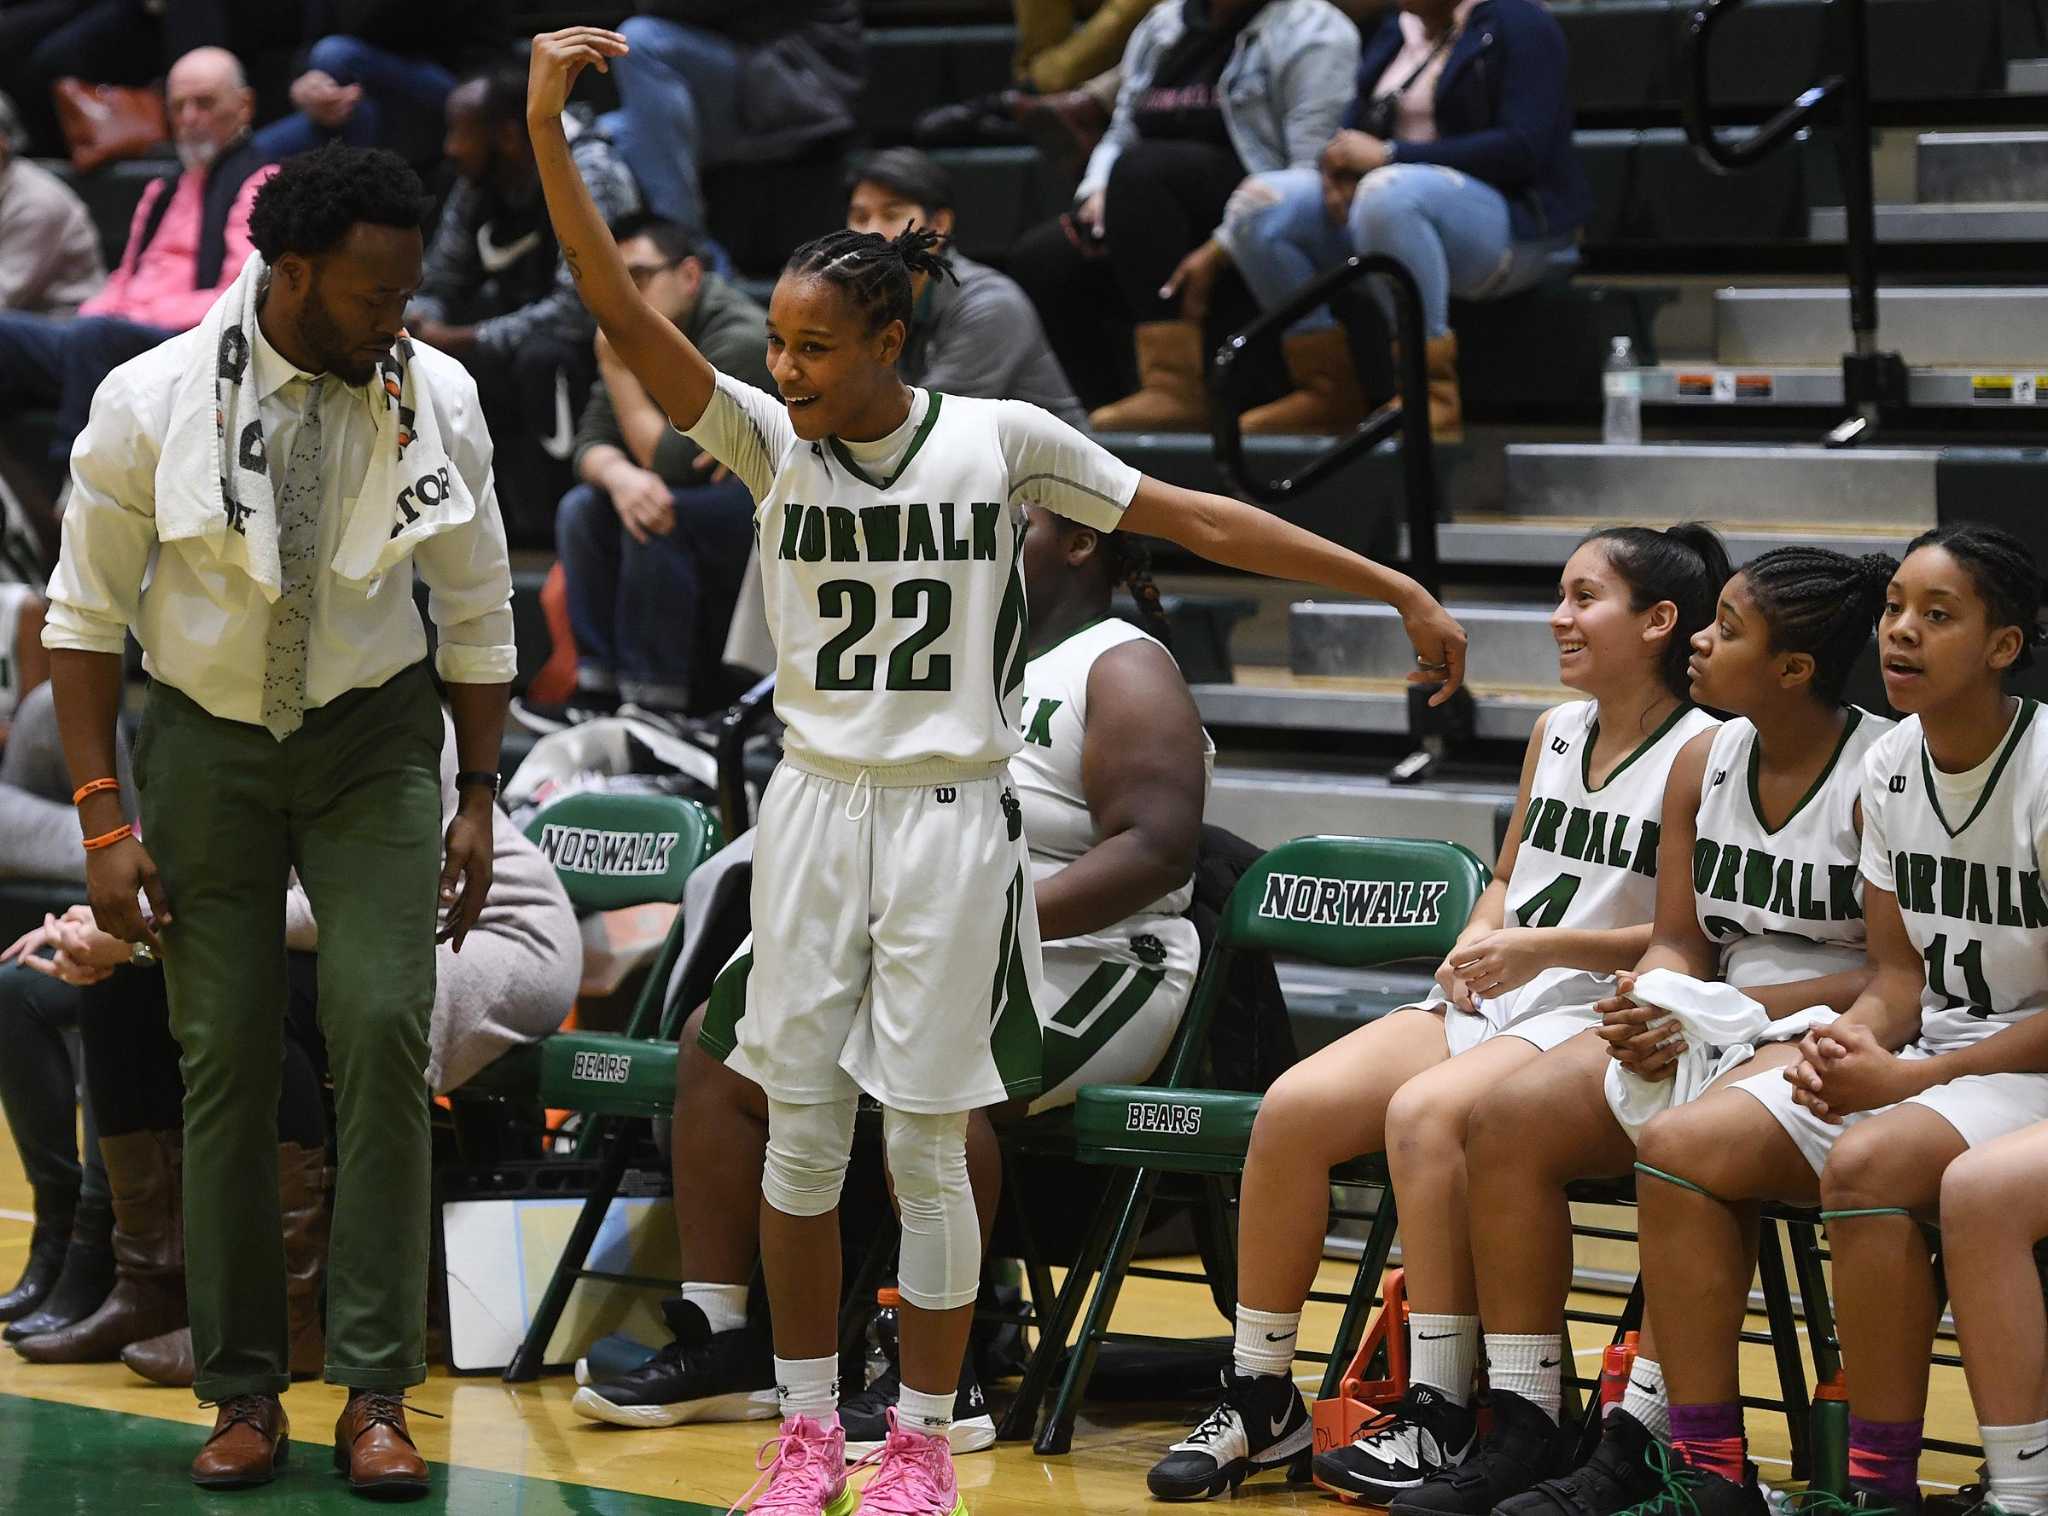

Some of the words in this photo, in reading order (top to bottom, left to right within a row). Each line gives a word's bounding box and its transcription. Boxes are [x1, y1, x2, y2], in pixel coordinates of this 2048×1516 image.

[779, 502, 1000, 562] NORWALK
[815, 579, 951, 691] 22
[539, 824, 680, 876] NORWALK
[1259, 873, 1448, 927] NORWALK
[1887, 849, 2048, 929] ORWALK
[1923, 932, 1999, 1020] 11
[573, 1051, 632, 1084] BEARS
[1126, 1103, 1202, 1135] BEARS
